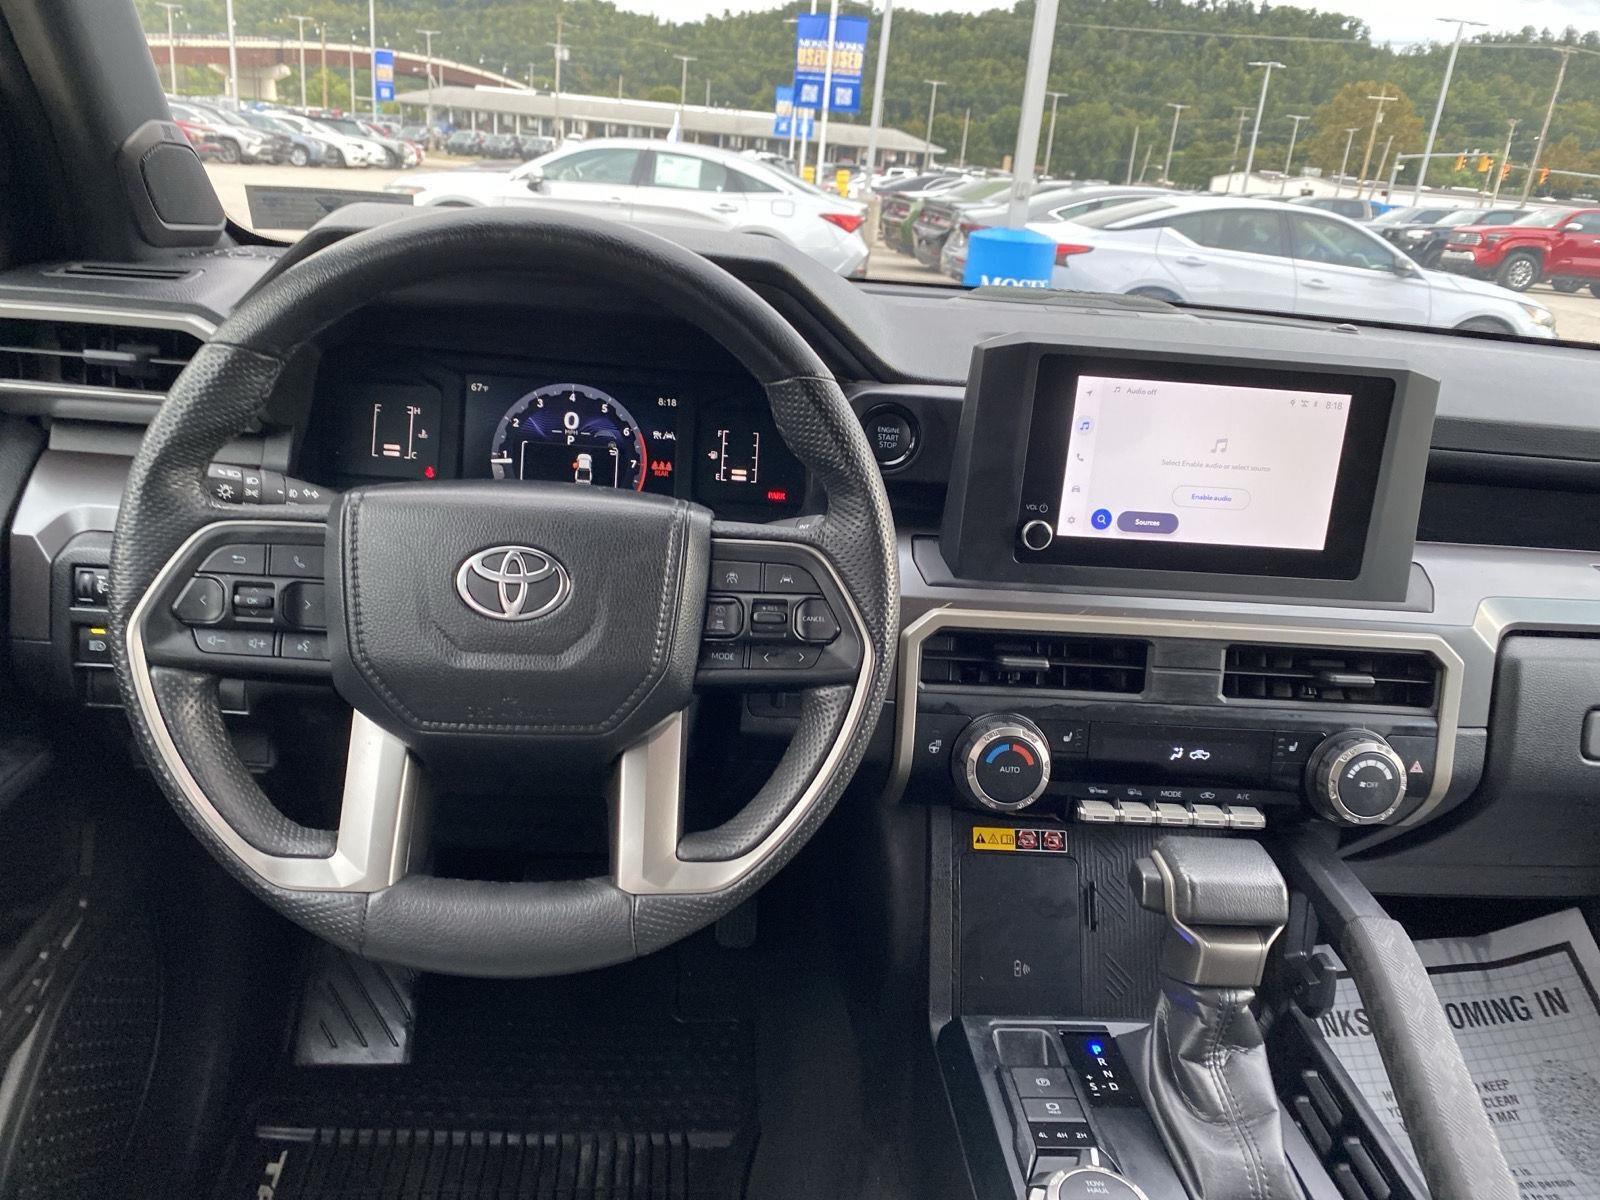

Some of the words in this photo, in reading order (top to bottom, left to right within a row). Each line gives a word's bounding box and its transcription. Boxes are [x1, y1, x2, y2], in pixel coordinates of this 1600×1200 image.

[1126, 386, 1146, 395] Audio
[569, 393, 576, 402] 4
[657, 397, 677, 407] 8:18
[536, 398, 544, 408] 3
[1325, 401, 1343, 410] 8:18
[413, 407, 421, 415] H
[601, 404, 608, 413] 5
[512, 418, 520, 428] 2
[563, 411, 580, 430] 0
[623, 427, 630, 437] 6
[717, 429, 722, 438] F
[877, 426, 900, 434] ENGINE
[567, 436, 576, 446] P
[878, 433, 899, 441] START
[879, 441, 897, 449] STOP
[411, 451, 418, 459] C
[630, 460, 637, 468] 7
[1162, 459, 1180, 467] Select
[1181, 460, 1203, 468] Enable
[715, 473, 721, 481] E
[1191, 493, 1213, 501] Enable
[1214, 494, 1232, 502] audio
[1026, 503, 1038, 511] VOL
[1134, 518, 1160, 527] Sources
[802, 615, 825, 623] CANCEL
[711, 652, 734, 661] MODE
[1000, 766, 1020, 774] AUTO
[1161, 790, 1182, 798] MODE
[1236, 793, 1250, 801] A/C
[1445, 995, 1533, 1029] OMING
[1533, 987, 1570, 1017] IN
[1321, 1008, 1371, 1037] NKS
[1091, 1044, 1102, 1055] P
[1097, 1057, 1108, 1066] R
[1103, 1070, 1114, 1078] N
[1089, 1082, 1098, 1090] S
[1108, 1082, 1119, 1090] D
[1481, 1079, 1509, 1093] KEEP
[1481, 1095, 1520, 1108] CLEAN
[1495, 1110, 1521, 1122] MAT
[1056, 1131, 1068, 1139] 4H
